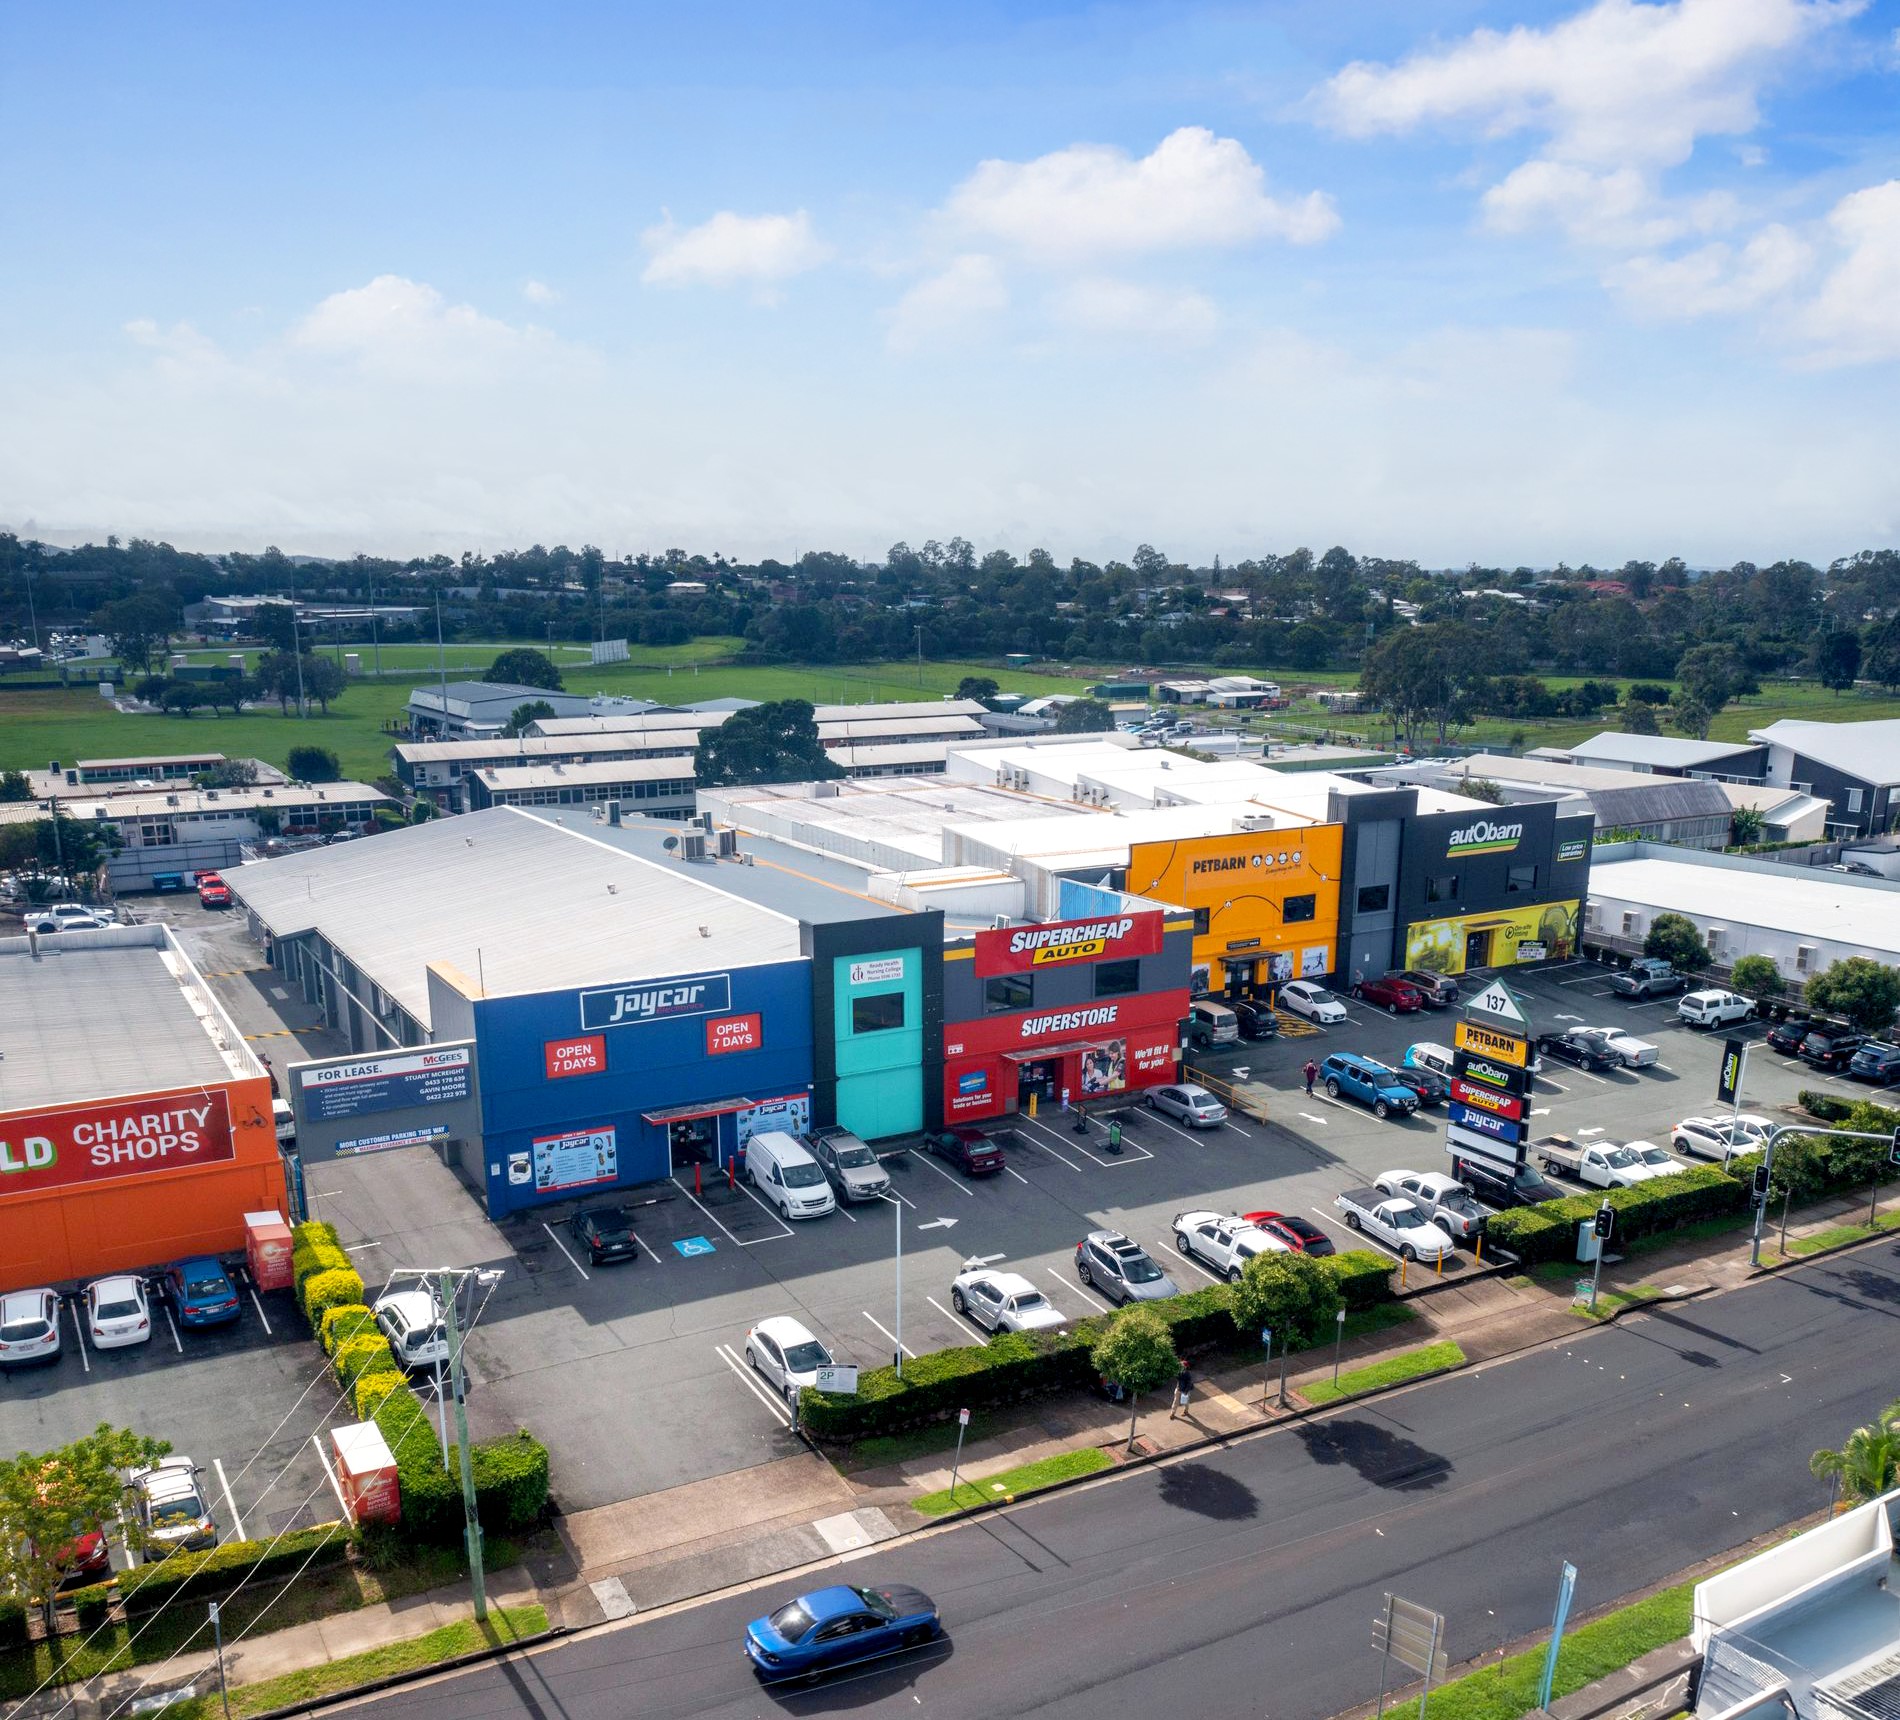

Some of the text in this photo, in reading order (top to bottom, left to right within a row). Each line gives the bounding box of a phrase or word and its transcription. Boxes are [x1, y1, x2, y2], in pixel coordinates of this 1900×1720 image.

[1560, 849, 1583, 858] guarantee
[1193, 856, 1246, 873] PETBARN
[1009, 919, 1134, 953] SUPERCHEAP
[1042, 943, 1096, 959] AUTO
[609, 985, 705, 1022] Jaycar
[1486, 994, 1507, 1012] 137
[716, 1022, 749, 1035] OPEN
[1021, 1005, 1118, 1037] SUPERSTORE
[712, 1033, 753, 1048] 7 DAYS
[1466, 1028, 1515, 1053] PETBARN
[556, 1044, 592, 1058] OPEN
[1135, 1044, 1169, 1059] We'll fit it
[552, 1056, 597, 1072] 7 DAYS
[1138, 1058, 1165, 1070] for you
[317, 1064, 383, 1081] FOR LEASE.
[404, 1073, 430, 1082] STUART
[441, 1082, 466, 1091] MOORE
[952, 1096, 974, 1104] Solutions
[971, 1098, 992, 1106] business
[1459, 1083, 1512, 1107] SUPERCHEAP
[1471, 1097, 1495, 1107] AUTO
[73, 1106, 211, 1146] CHARITY
[339, 1126, 445, 1149] MORE CUSTOMER PARKING THIS WAY
[90, 1131, 200, 1166] SHOPS
[820, 1371, 835, 1380] 2P
